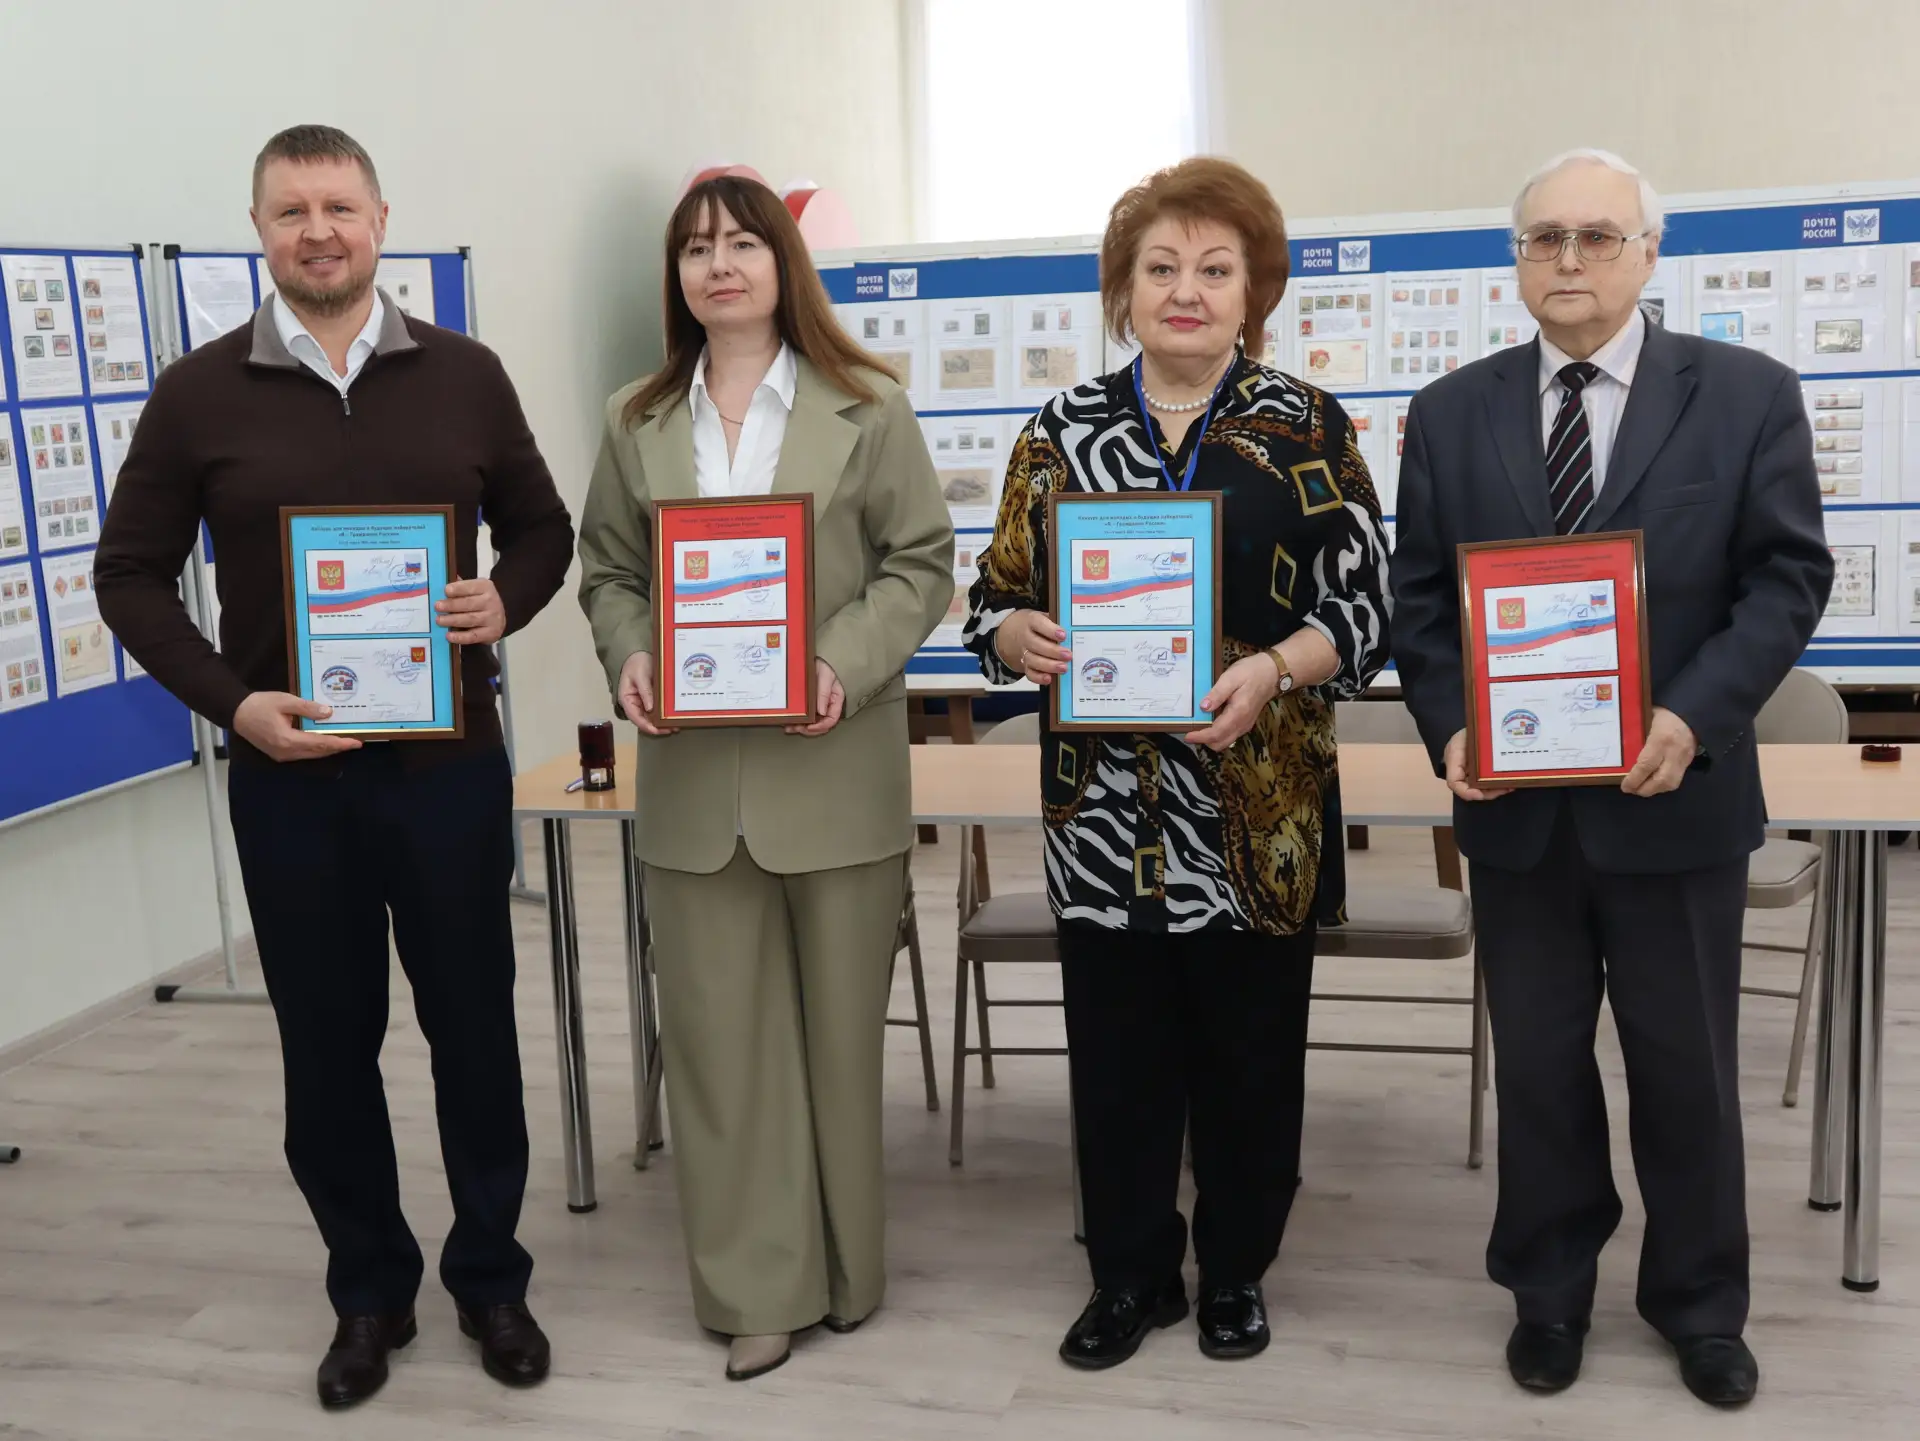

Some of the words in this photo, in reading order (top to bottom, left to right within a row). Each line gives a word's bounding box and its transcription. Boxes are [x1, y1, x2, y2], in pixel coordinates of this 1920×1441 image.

[1803, 217, 1836, 228] ПОЧТА
[1803, 228, 1837, 239] РОССИИ
[1303, 247, 1333, 258] ПОЧТА
[1303, 258, 1333, 268] РОССИИ
[856, 275, 884, 285] ПОЧТА
[856, 285, 884, 295] РОССИИ
